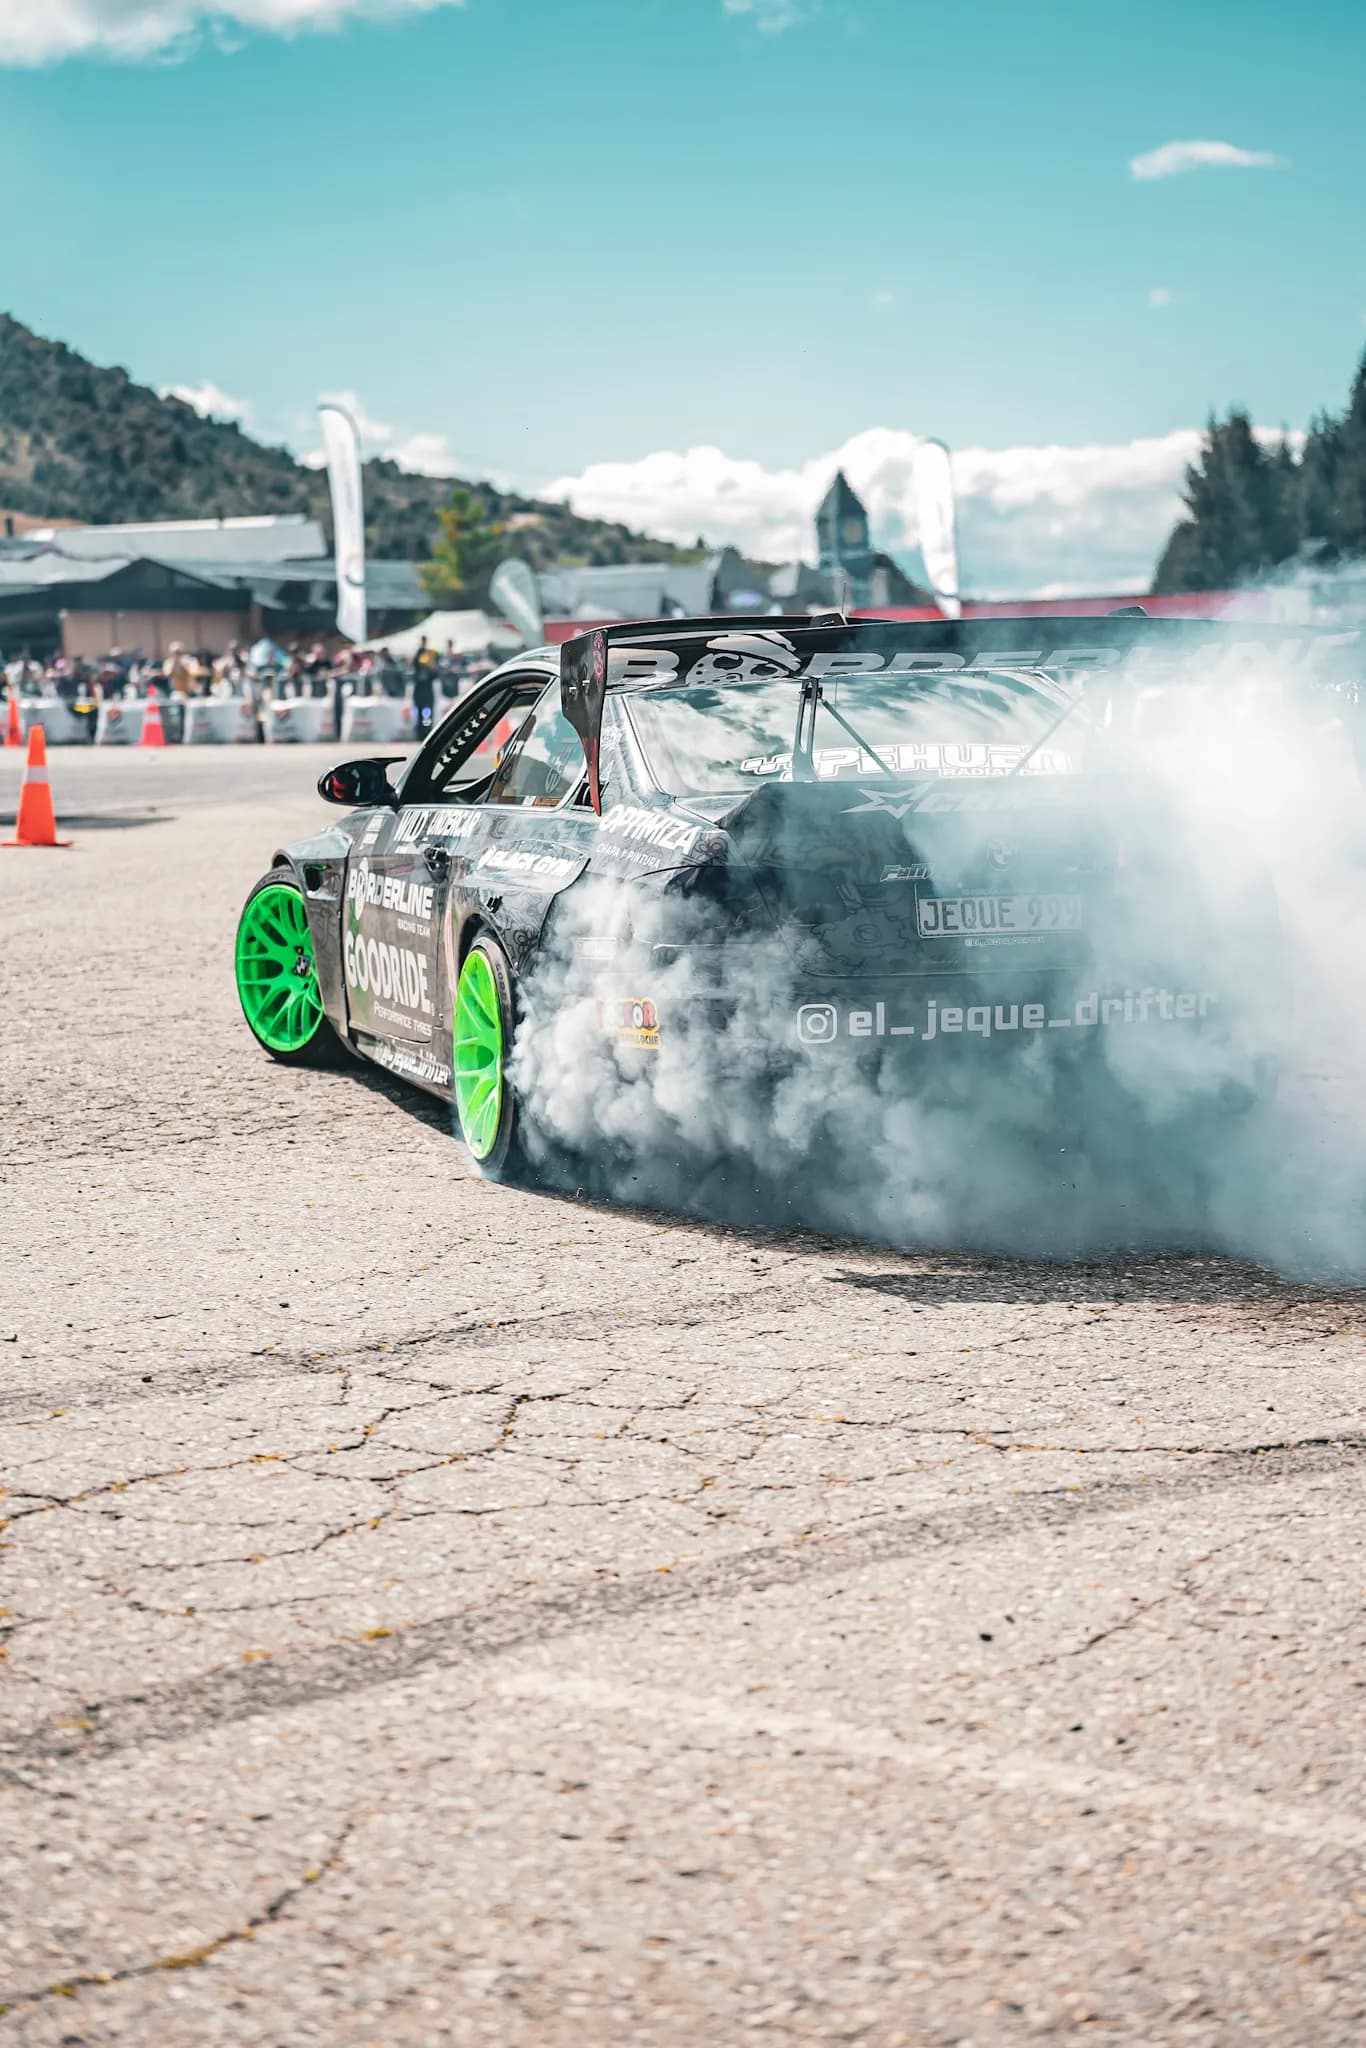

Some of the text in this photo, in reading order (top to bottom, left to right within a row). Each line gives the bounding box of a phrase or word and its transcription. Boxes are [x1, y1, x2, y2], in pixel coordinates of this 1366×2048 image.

[393, 808, 429, 842] WILD
[599, 804, 702, 855] OPTIMIZA
[628, 850, 660, 869] PINTURA
[923, 897, 1077, 932] JEQUE 999
[848, 990, 1217, 1041] el_jeque_drifter
